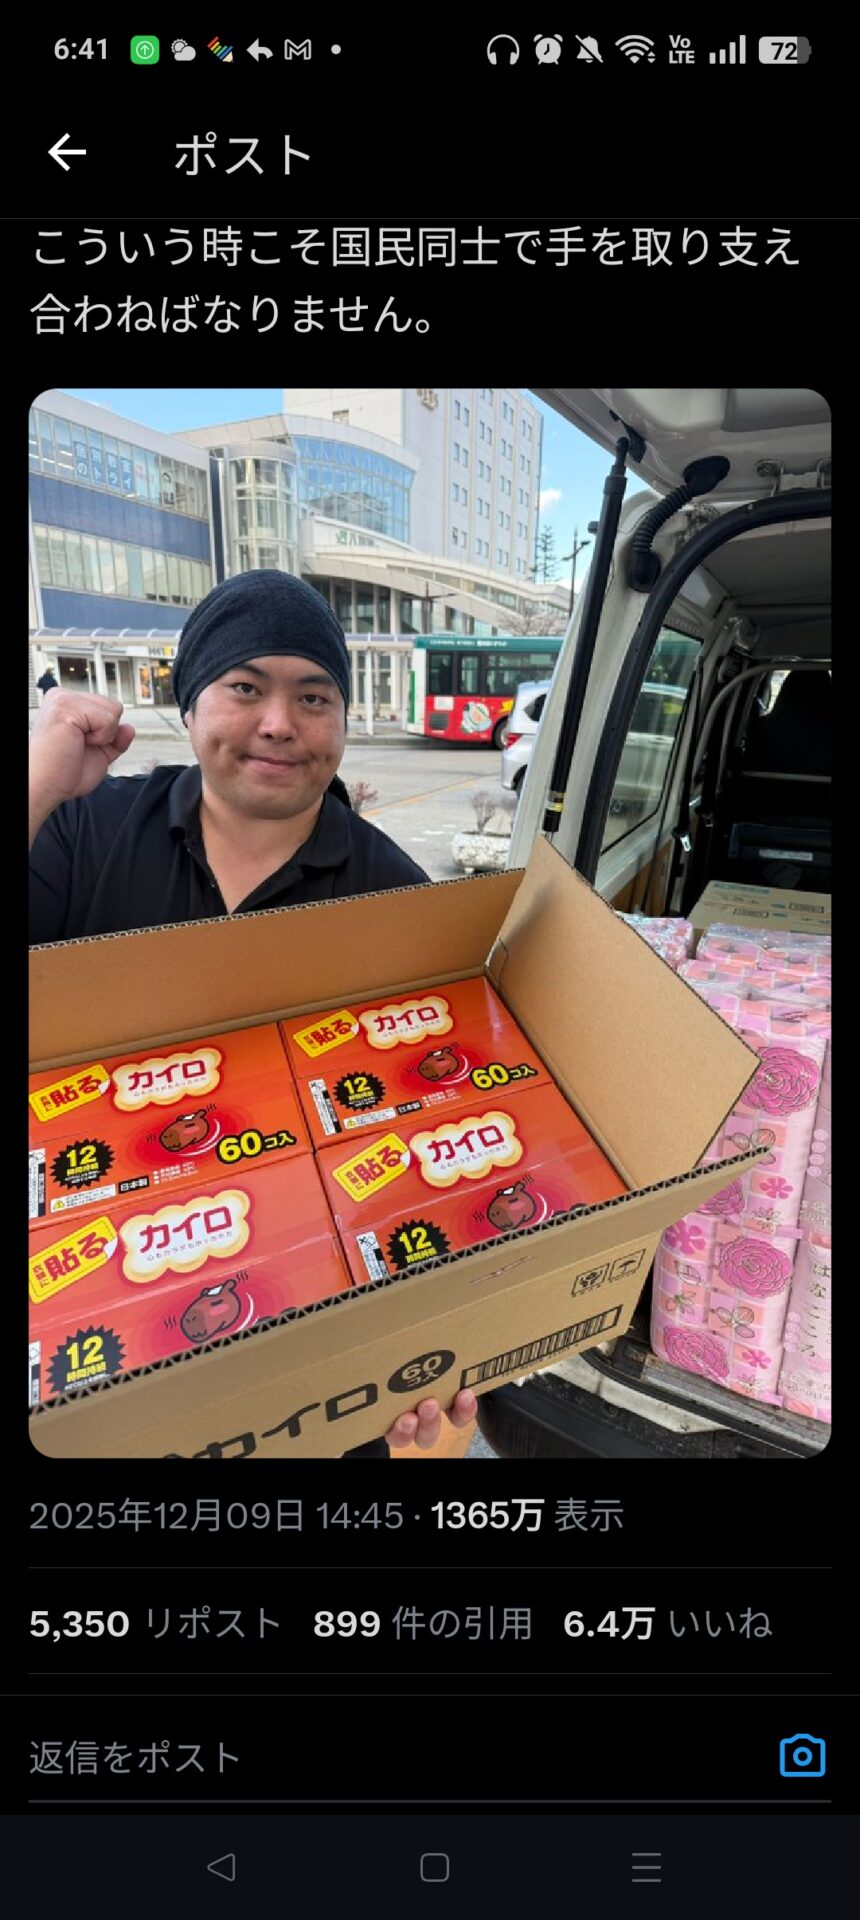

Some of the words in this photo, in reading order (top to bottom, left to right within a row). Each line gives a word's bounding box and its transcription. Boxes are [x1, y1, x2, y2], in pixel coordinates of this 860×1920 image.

[54, 38, 106, 60] 6:41
[669, 35, 691, 48] Vo
[669, 50, 695, 64] LTE
[771, 42, 797, 60] 72
[175, 131, 310, 175] ポスト
[36, 225, 799, 267] こういう時こそ国民同士で手を取り支え
[30, 293, 429, 334] 合わねばなりません。
[310, 1018, 352, 1046] 貼る
[374, 1006, 439, 1032] カイロ
[49, 1075, 102, 1107] 貼る
[128, 1060, 206, 1090] カイロ
[343, 1077, 371, 1095] 12
[472, 1064, 535, 1088] 60コ入
[66, 1145, 97, 1168] 12
[219, 1131, 294, 1163] 60コ入
[427, 1125, 505, 1163] カイロ
[354, 1145, 402, 1186] 貼る
[140, 1206, 232, 1253] カイロ
[400, 1226, 432, 1254] 12
[44, 1232, 109, 1281] 貼る
[66, 1335, 104, 1370] 12
[402, 1354, 442, 1382] 60
[192, 1383, 378, 1458] カイロ
[30, 1497, 302, 1532] 2025年12月09日
[317, 1503, 403, 1528] 14:45
[431, 1499, 545, 1532] 1365万
[555, 1497, 623, 1531] 表示
[30, 1611, 129, 1642] 5,350
[149, 1605, 279, 1638] リポスト
[314, 1611, 380, 1637] 899
[392, 1606, 530, 1640] 件の引用
[564, 1607, 656, 1640] 6.4万
[670, 1607, 772, 1638] いいね
[30, 1740, 238, 1774] 返信をポスト
